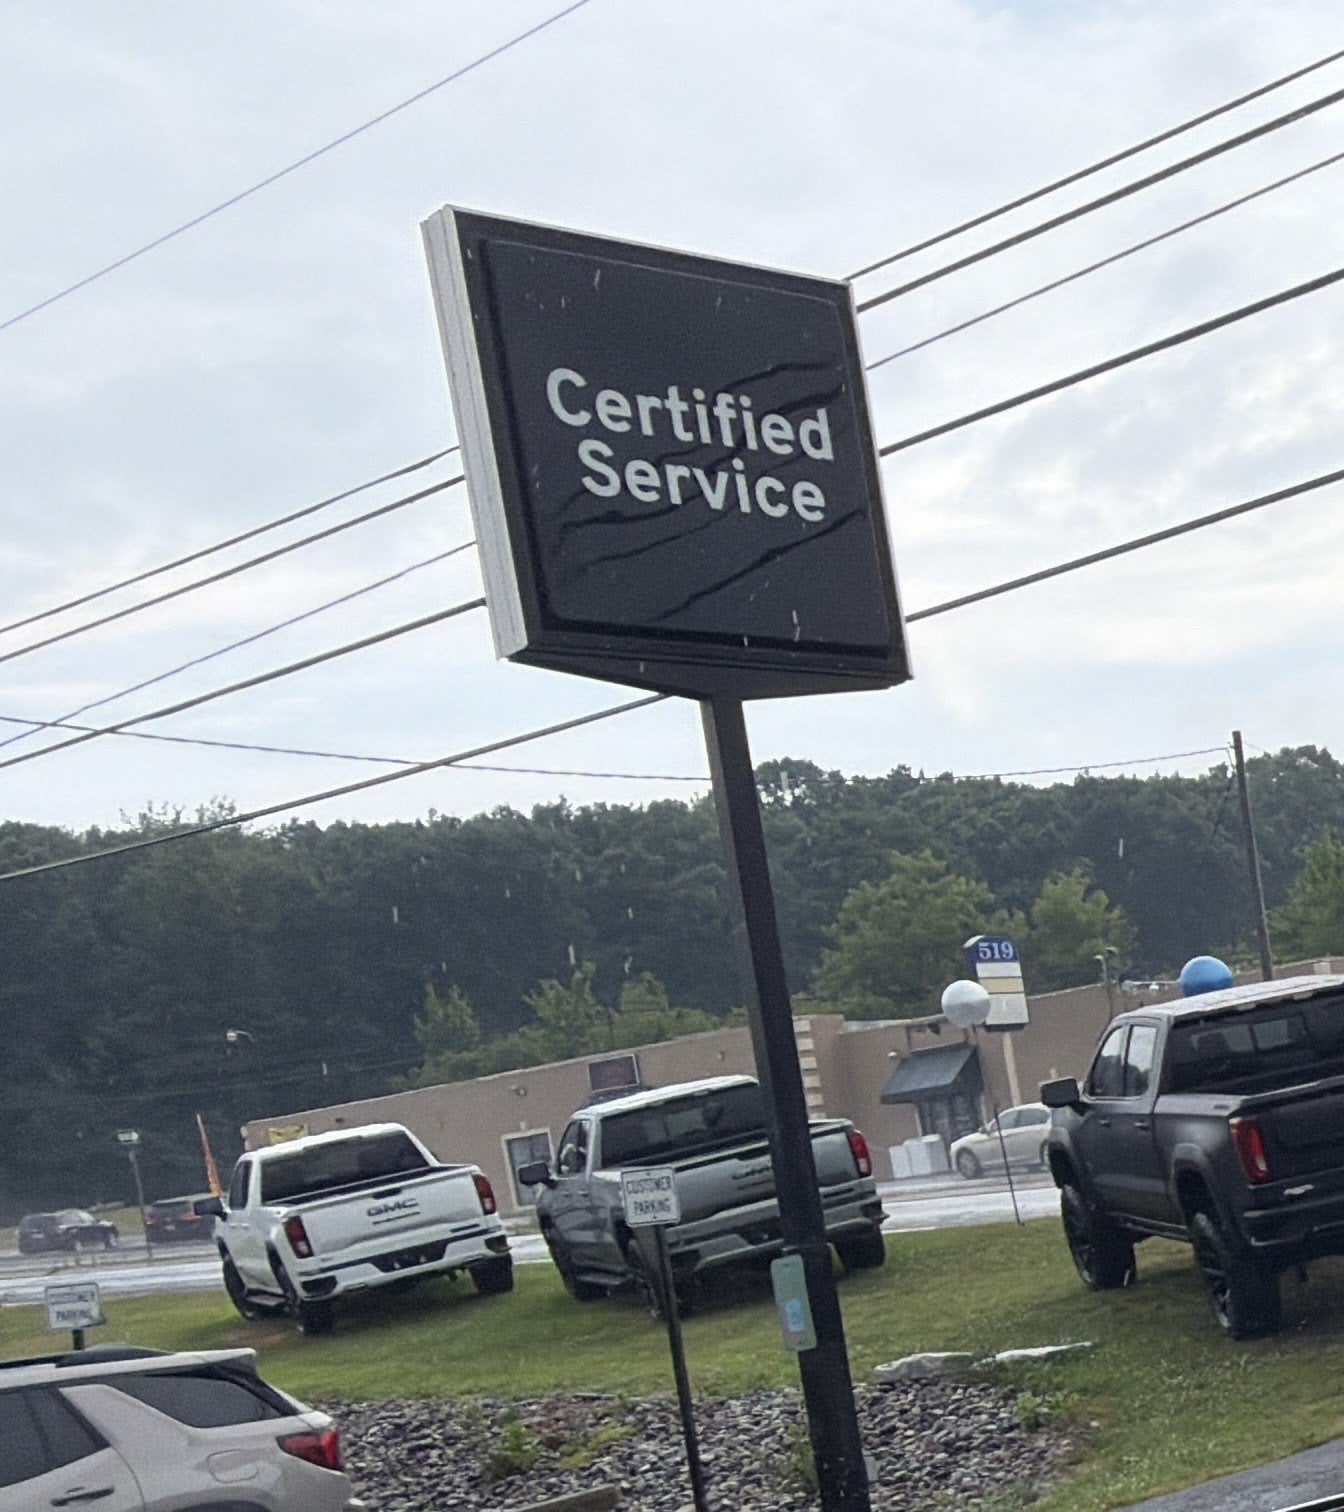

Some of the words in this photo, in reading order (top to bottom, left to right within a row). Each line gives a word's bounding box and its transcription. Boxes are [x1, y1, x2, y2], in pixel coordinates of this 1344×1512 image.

[546, 367, 835, 461] Certified
[578, 438, 826, 522] Service
[978, 941, 1014, 960] 519
[367, 1198, 419, 1217] GMC
